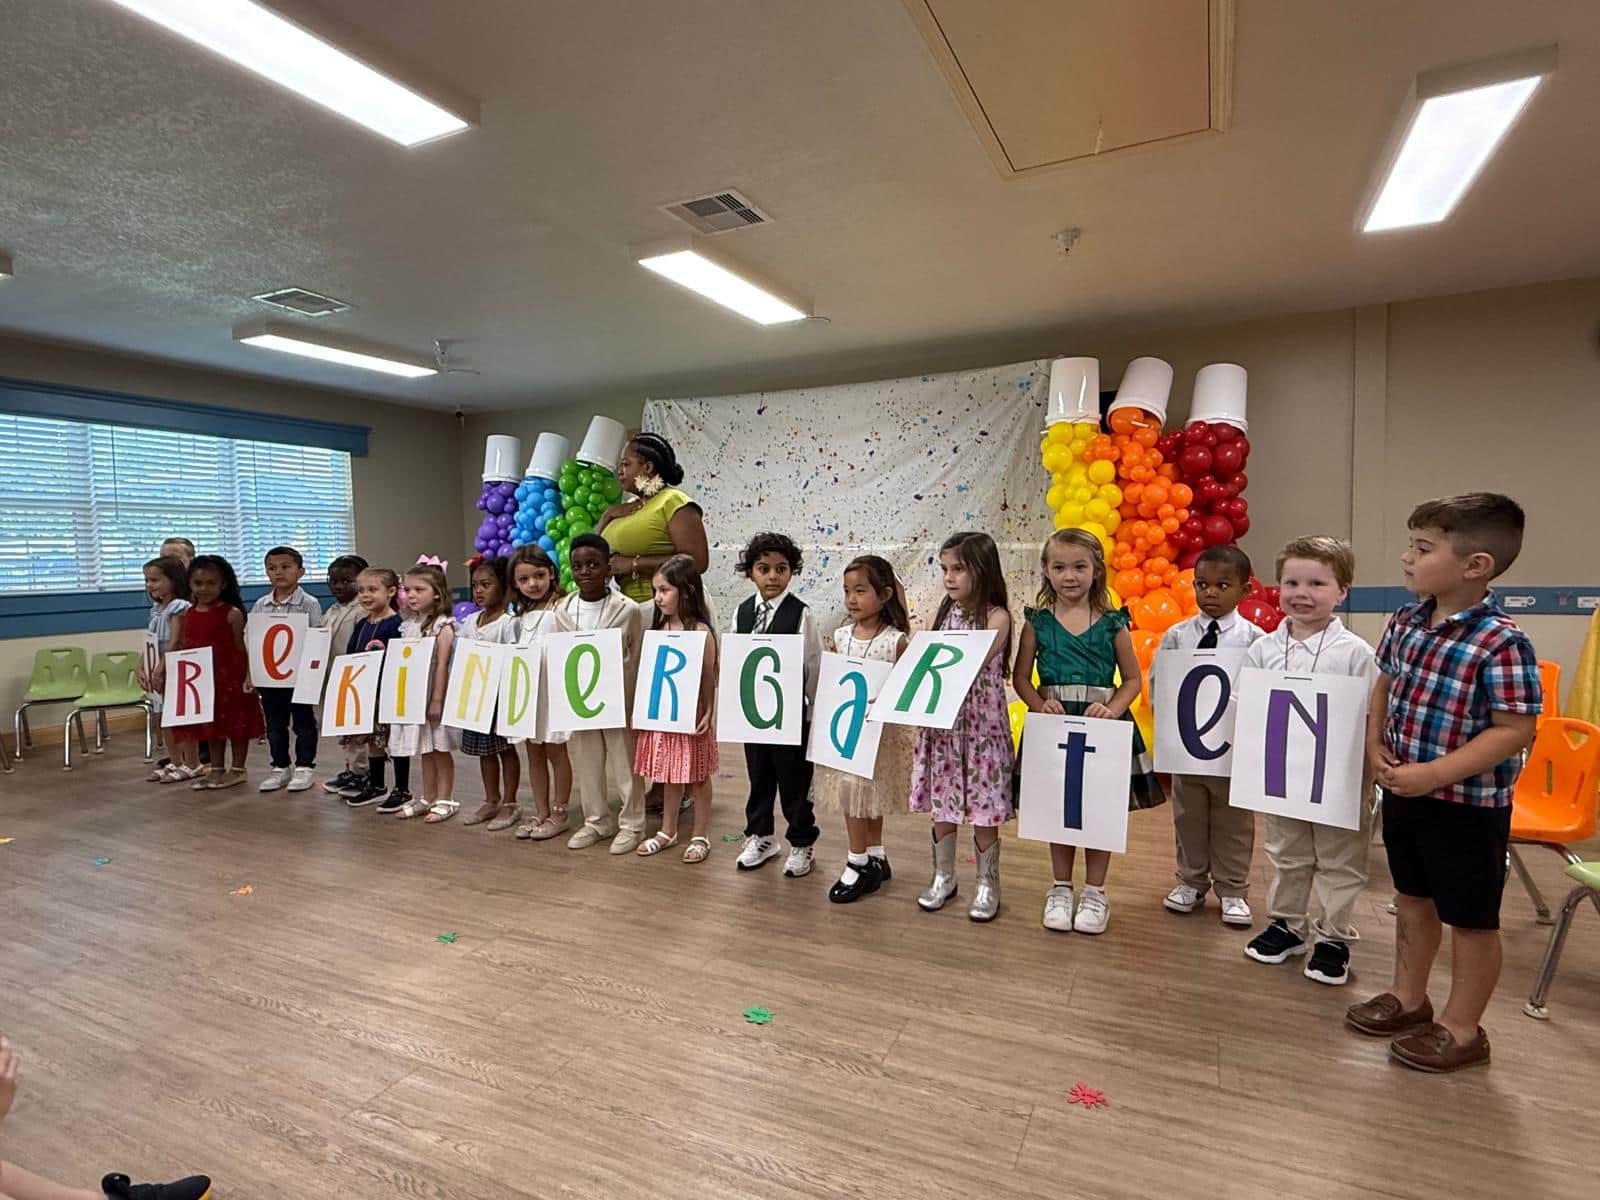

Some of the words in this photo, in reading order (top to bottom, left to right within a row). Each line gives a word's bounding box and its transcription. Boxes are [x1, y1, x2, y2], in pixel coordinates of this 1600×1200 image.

[176, 660, 202, 717] R
[335, 664, 367, 728] K
[396, 646, 413, 718] i
[456, 653, 492, 723] N
[507, 655, 531, 727] D
[647, 644, 688, 723] R
[739, 646, 784, 731] G
[894, 642, 964, 715] R
[1264, 689, 1328, 805] N
